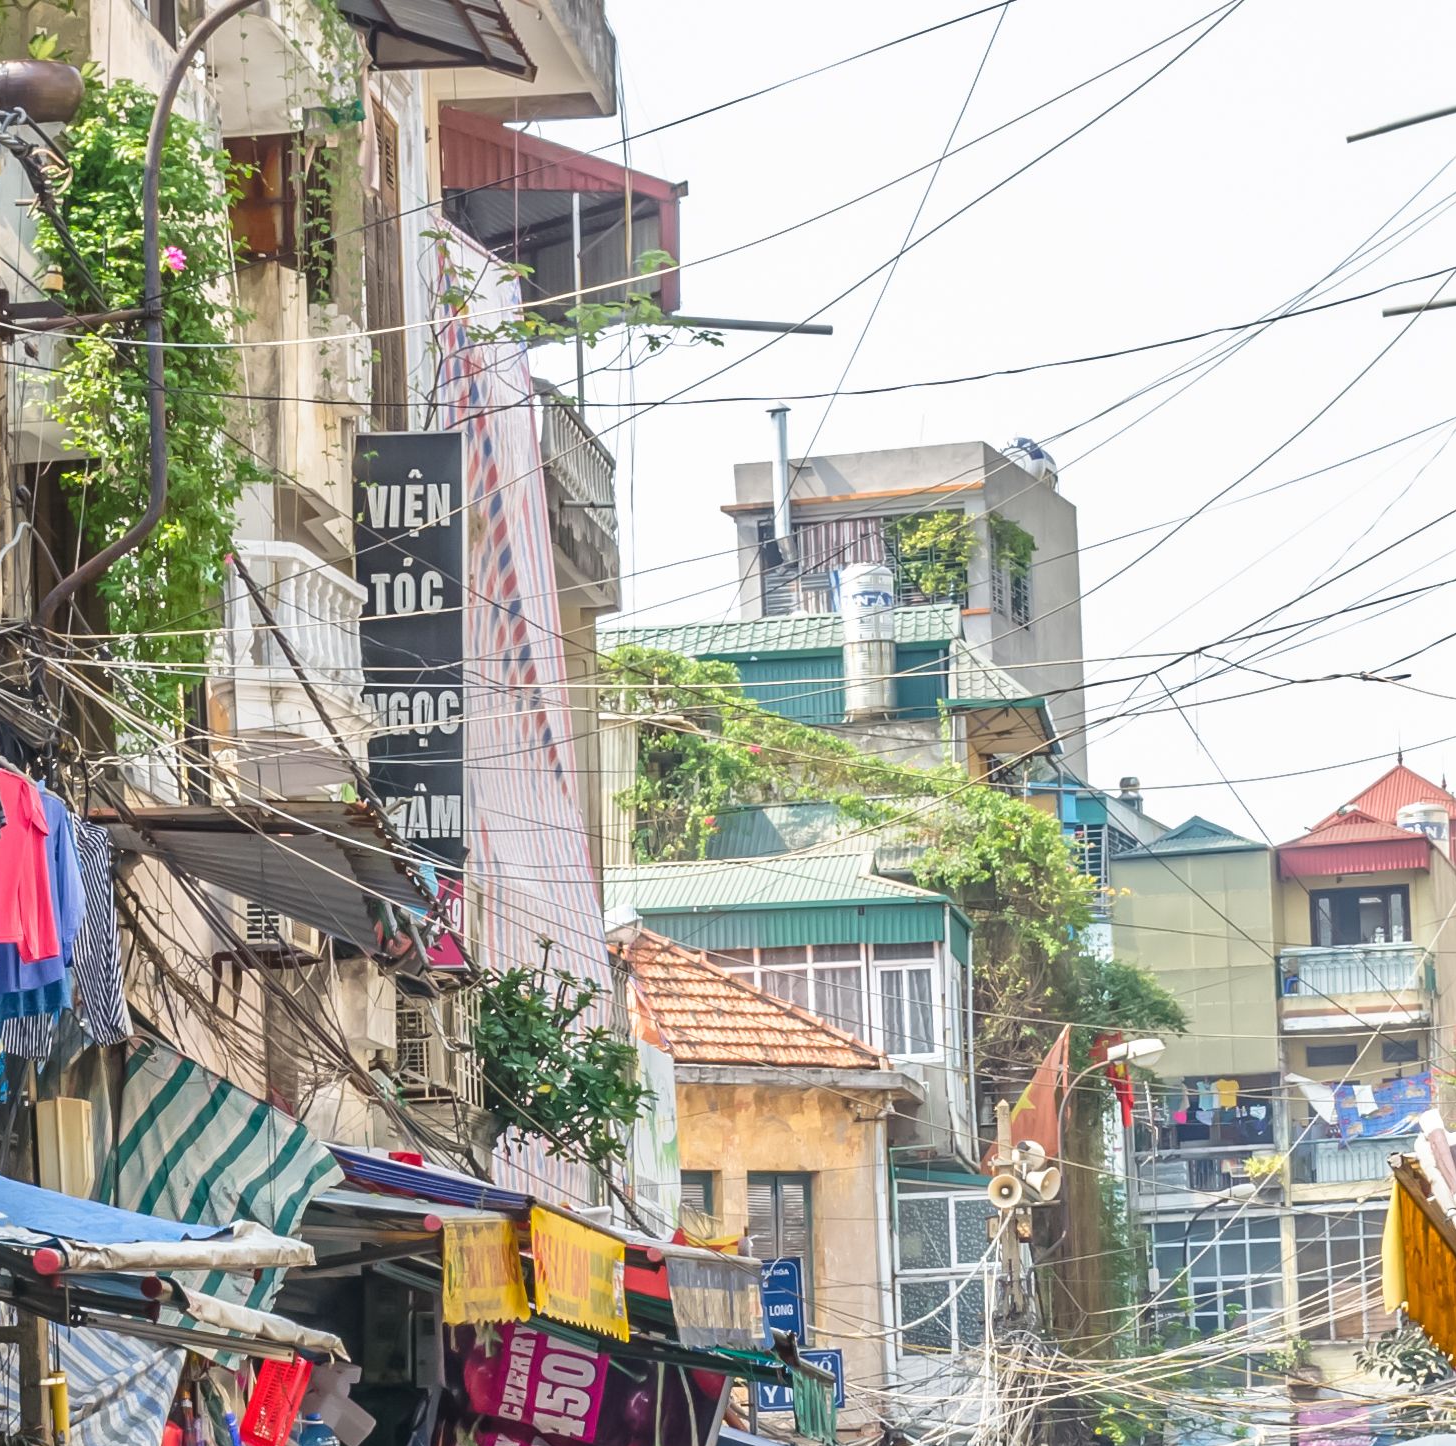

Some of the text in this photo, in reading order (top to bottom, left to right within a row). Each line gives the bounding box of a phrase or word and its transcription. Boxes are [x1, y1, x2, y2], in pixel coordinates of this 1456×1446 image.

[366, 468, 451, 537] VIỆN
[370, 556, 444, 615] TÓC
[363, 691, 461, 747] NGỌC
[768, 1304, 794, 1317] LONG
[498, 1322, 538, 1423] CHERRY
